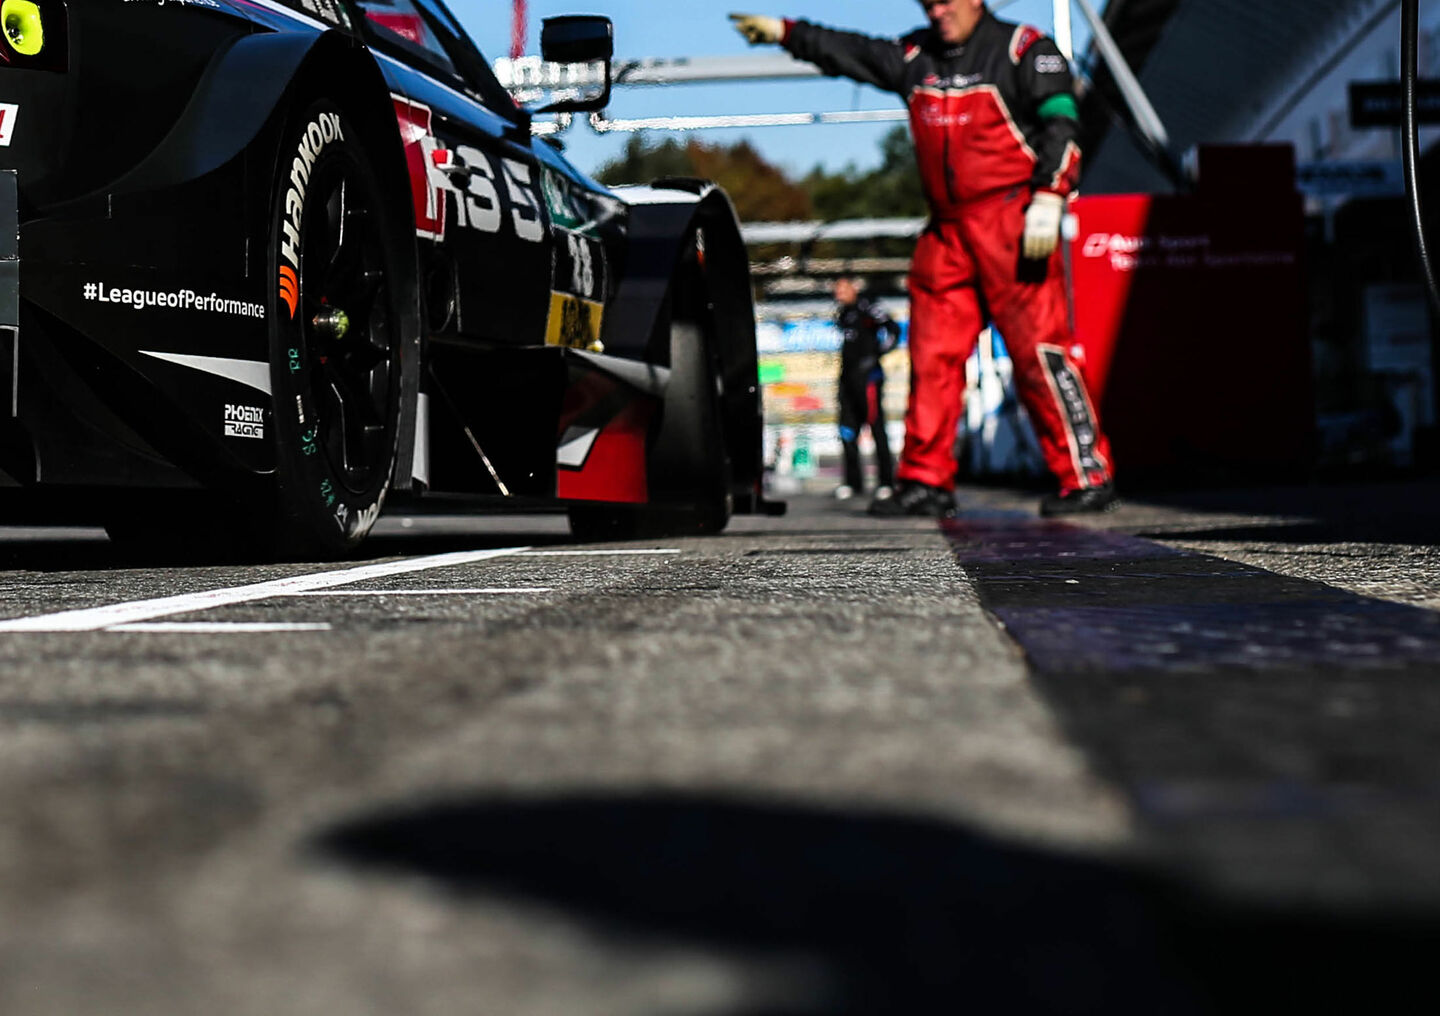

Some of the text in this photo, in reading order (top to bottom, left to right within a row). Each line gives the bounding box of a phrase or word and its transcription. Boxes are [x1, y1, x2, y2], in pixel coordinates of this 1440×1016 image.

[501, 157, 545, 243] 5
[83, 282, 265, 319] #LeagueofPerformance
[225, 404, 263, 423] PHOENIX
